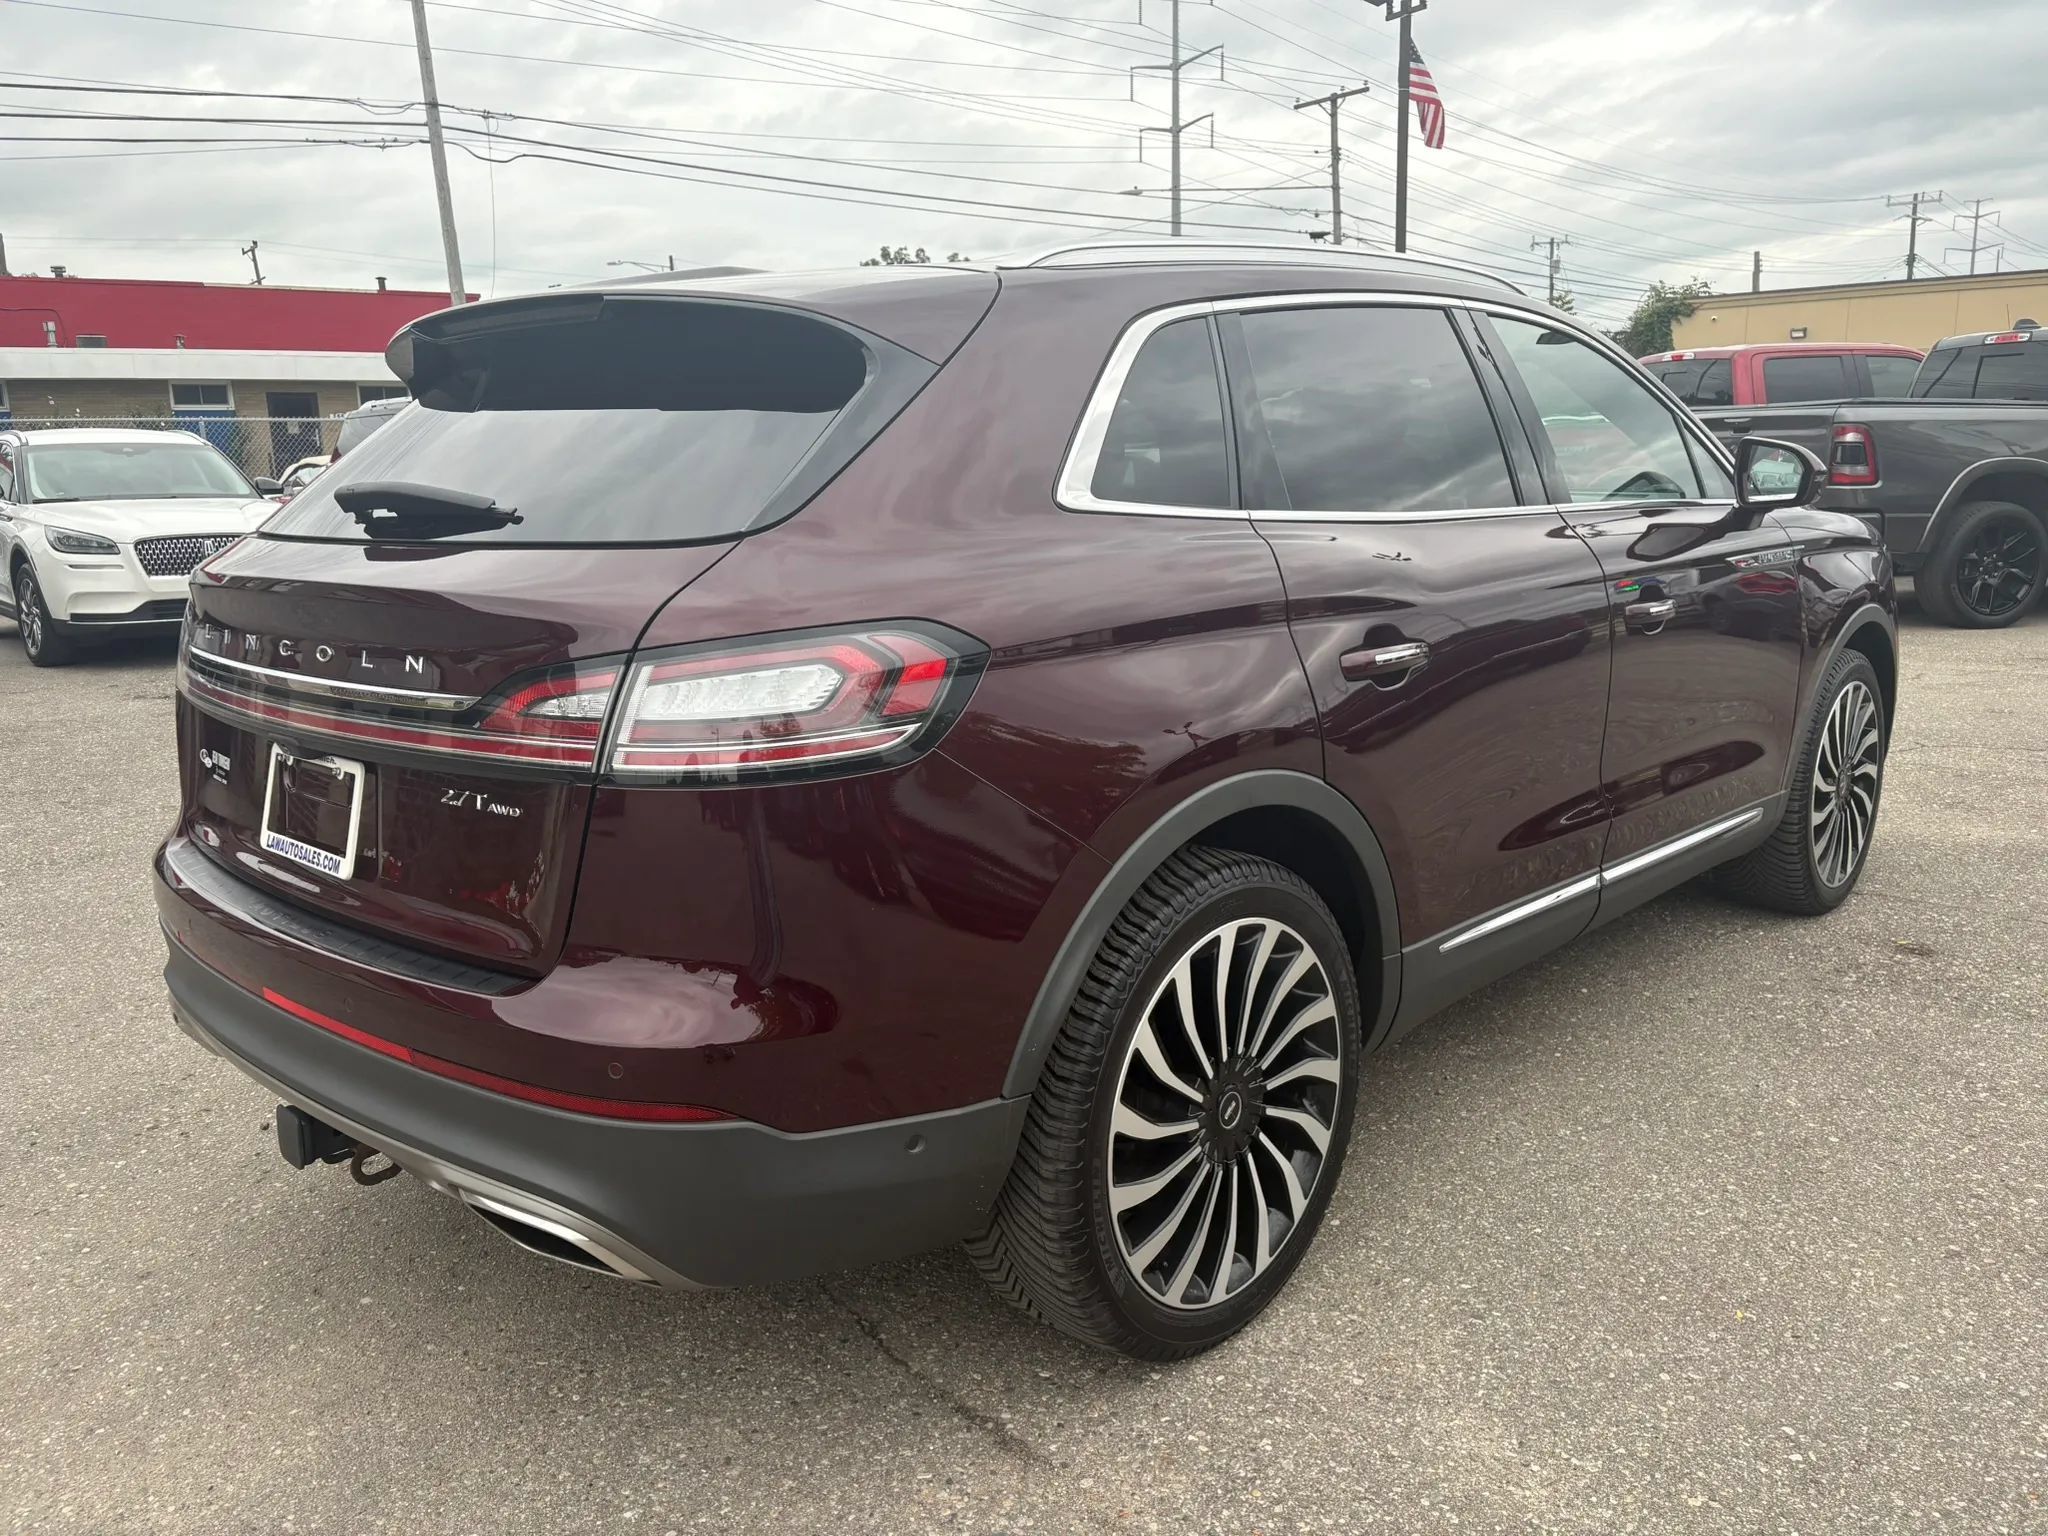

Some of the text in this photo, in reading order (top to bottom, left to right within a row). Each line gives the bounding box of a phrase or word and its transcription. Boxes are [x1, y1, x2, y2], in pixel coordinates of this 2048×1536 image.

[205, 623, 424, 674] LINCOLN
[487, 803, 521, 817] AWD
[266, 834, 341, 875] LAWAUTOSALES.COM
